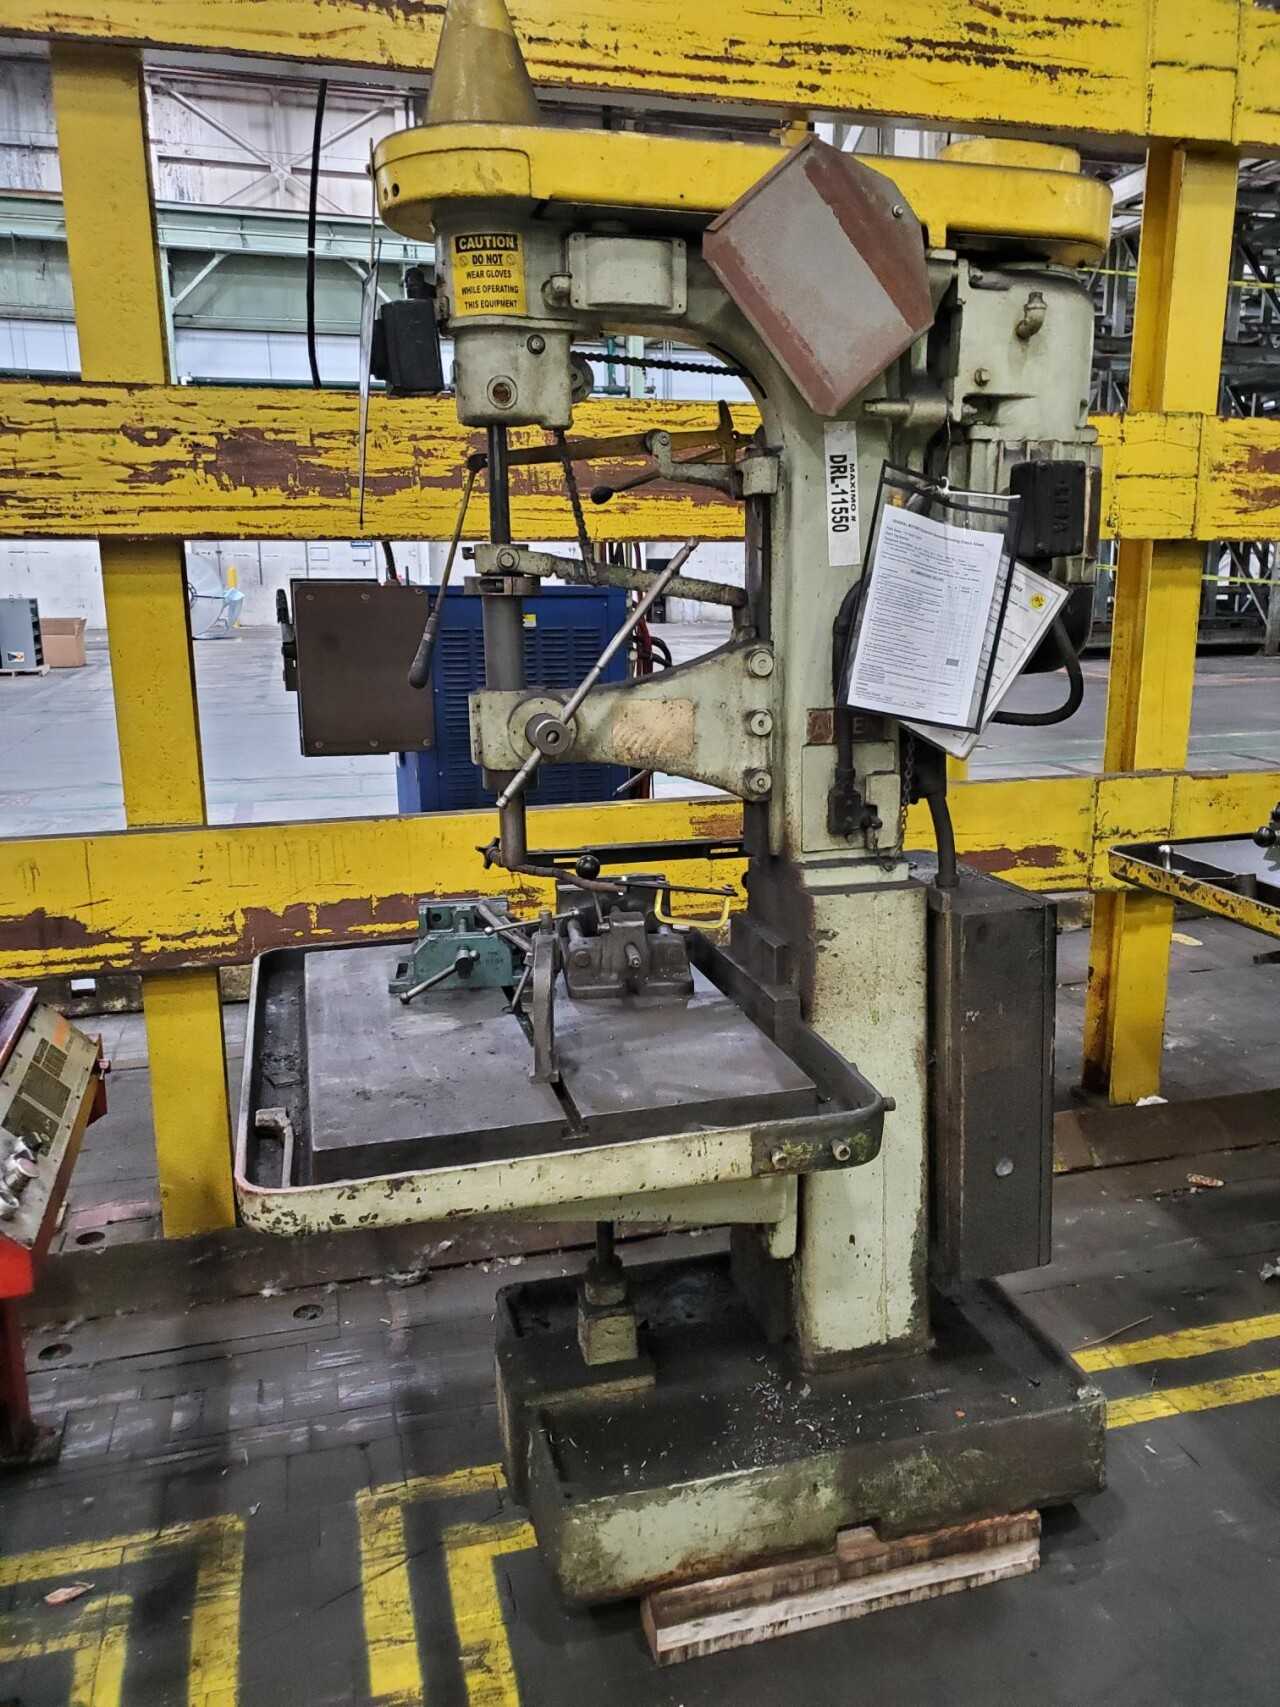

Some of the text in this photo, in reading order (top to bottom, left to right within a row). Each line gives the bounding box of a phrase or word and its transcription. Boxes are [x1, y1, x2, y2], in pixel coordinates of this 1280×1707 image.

[459, 236, 514, 249] CAUTION
[472, 253, 503, 265] DO NOT
[466, 269, 512, 280] WEAR GLOVES
[461, 284, 519, 295] WHILE OPERATING
[464, 299, 518, 310] THIS EQUIPMENT
[830, 455, 849, 532] DRL-11550
